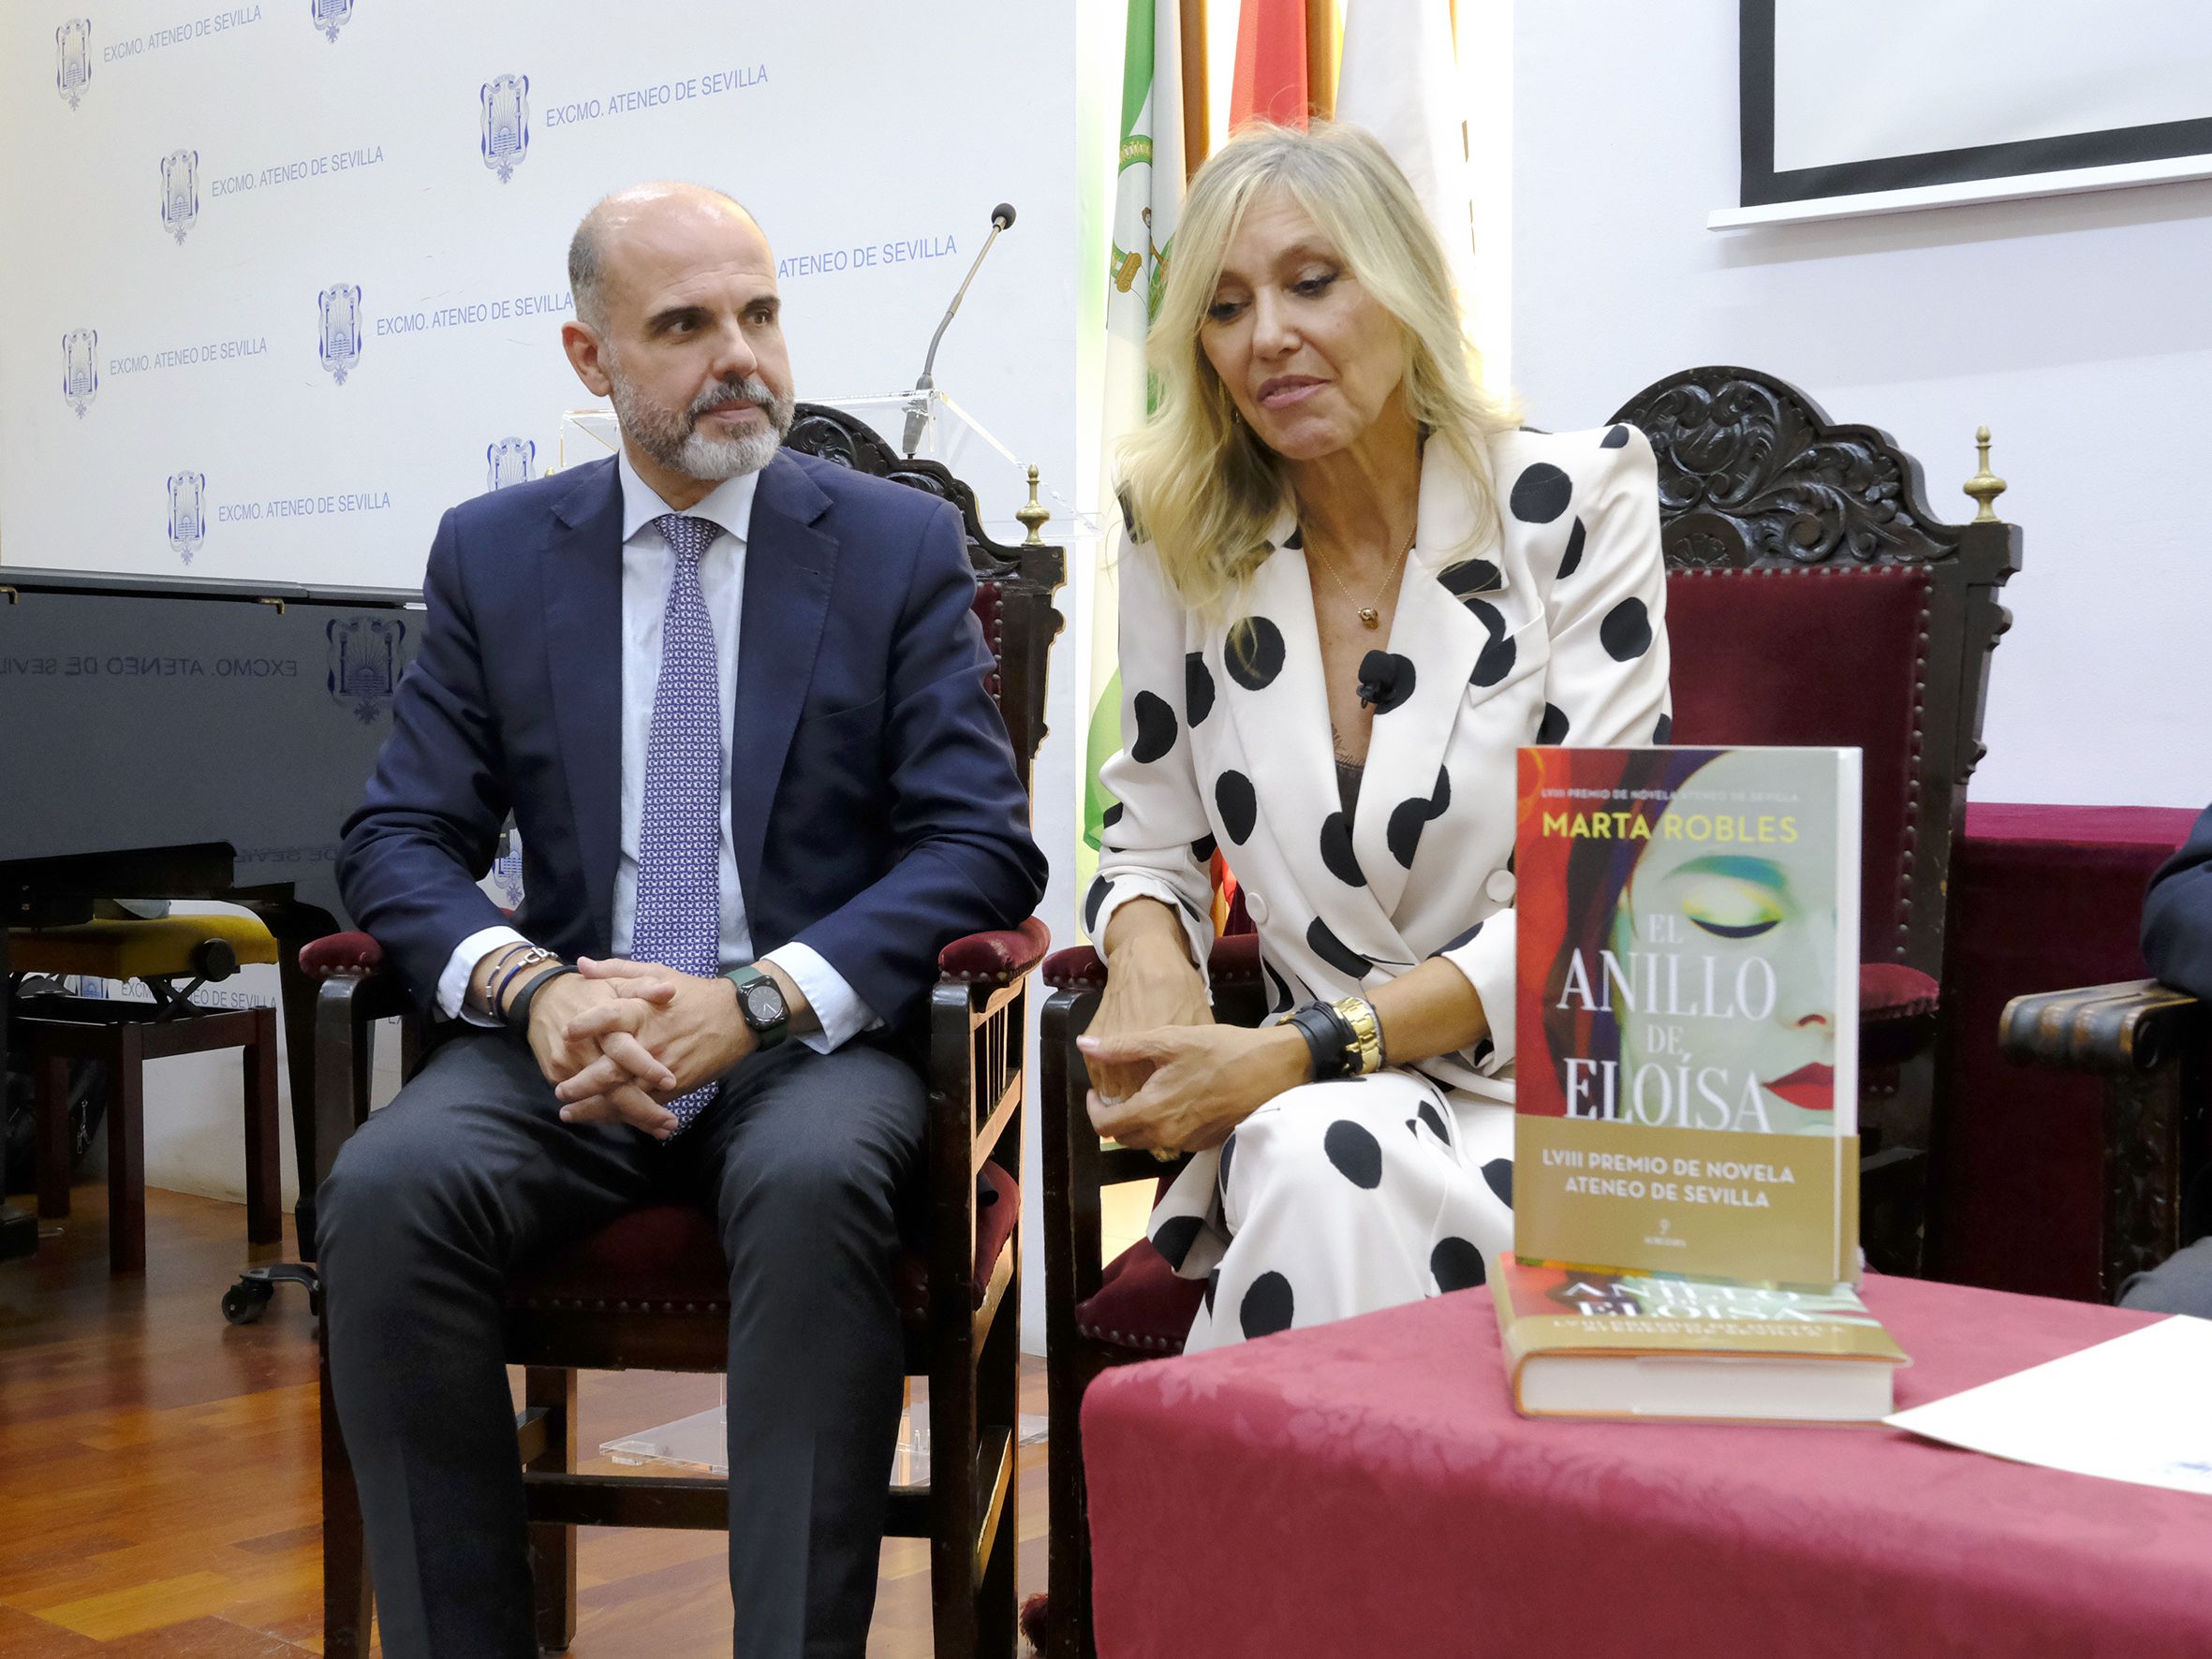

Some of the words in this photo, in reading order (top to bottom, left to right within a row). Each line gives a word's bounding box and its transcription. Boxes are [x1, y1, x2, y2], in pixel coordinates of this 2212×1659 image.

[104, 38, 145, 63] EXCMO.
[148, 23, 192, 51] ATENEO
[196, 19, 211, 37] DE
[214, 5, 261, 32] SEVILLA
[546, 99, 604, 127] EXCMO.
[608, 85, 671, 114] ATENEO
[675, 80, 697, 100] DE
[701, 65, 768, 95] SEVILLA
[212, 173, 257, 197] EXCMO.
[259, 162, 307, 186] ATENEO
[311, 157, 327, 176] DE
[331, 146, 384, 171] SEVILLA
[778, 251, 848, 279] ATENEO
[853, 246, 877, 269] DE
[882, 235, 957, 264] SEVILLA
[376, 313, 428, 336] EXCMO.
[432, 304, 487, 329] ATENEO
[492, 301, 510, 319] DE
[515, 291, 573, 316] SEVILLA
[110, 355, 152, 375] EXCMO.
[154, 347, 199, 370] ATENEO
[202, 345, 216, 362] DE
[220, 337, 267, 360] SEVILLA
[218, 503, 263, 522] EXCMO.
[266, 498, 315, 518] ATENEO
[317, 496, 334, 514] DE
[338, 492, 391, 512] SEVILLA
[1612, 789, 1628, 800] DE
[1542, 811, 1652, 840] MARTA
[1664, 815, 1799, 843] ROBLES
[1648, 914, 1684, 944] EL
[213, 991, 227, 1007] DE
[1556, 947, 1777, 1020] ANILLO
[1647, 1024, 1684, 1055] DE
[1563, 1053, 1774, 1134] ELOÍSA
[1542, 1149, 1583, 1168] LVIII
[1588, 1152, 1667, 1175] PREMIO
[1673, 1158, 1701, 1178] DE
[1706, 1161, 1795, 1184] NOVELA
[1565, 1176, 1645, 1199] ATENEO
[1651, 1182, 1678, 1201] DE
[1684, 1185, 1770, 1208] SEVILLA
